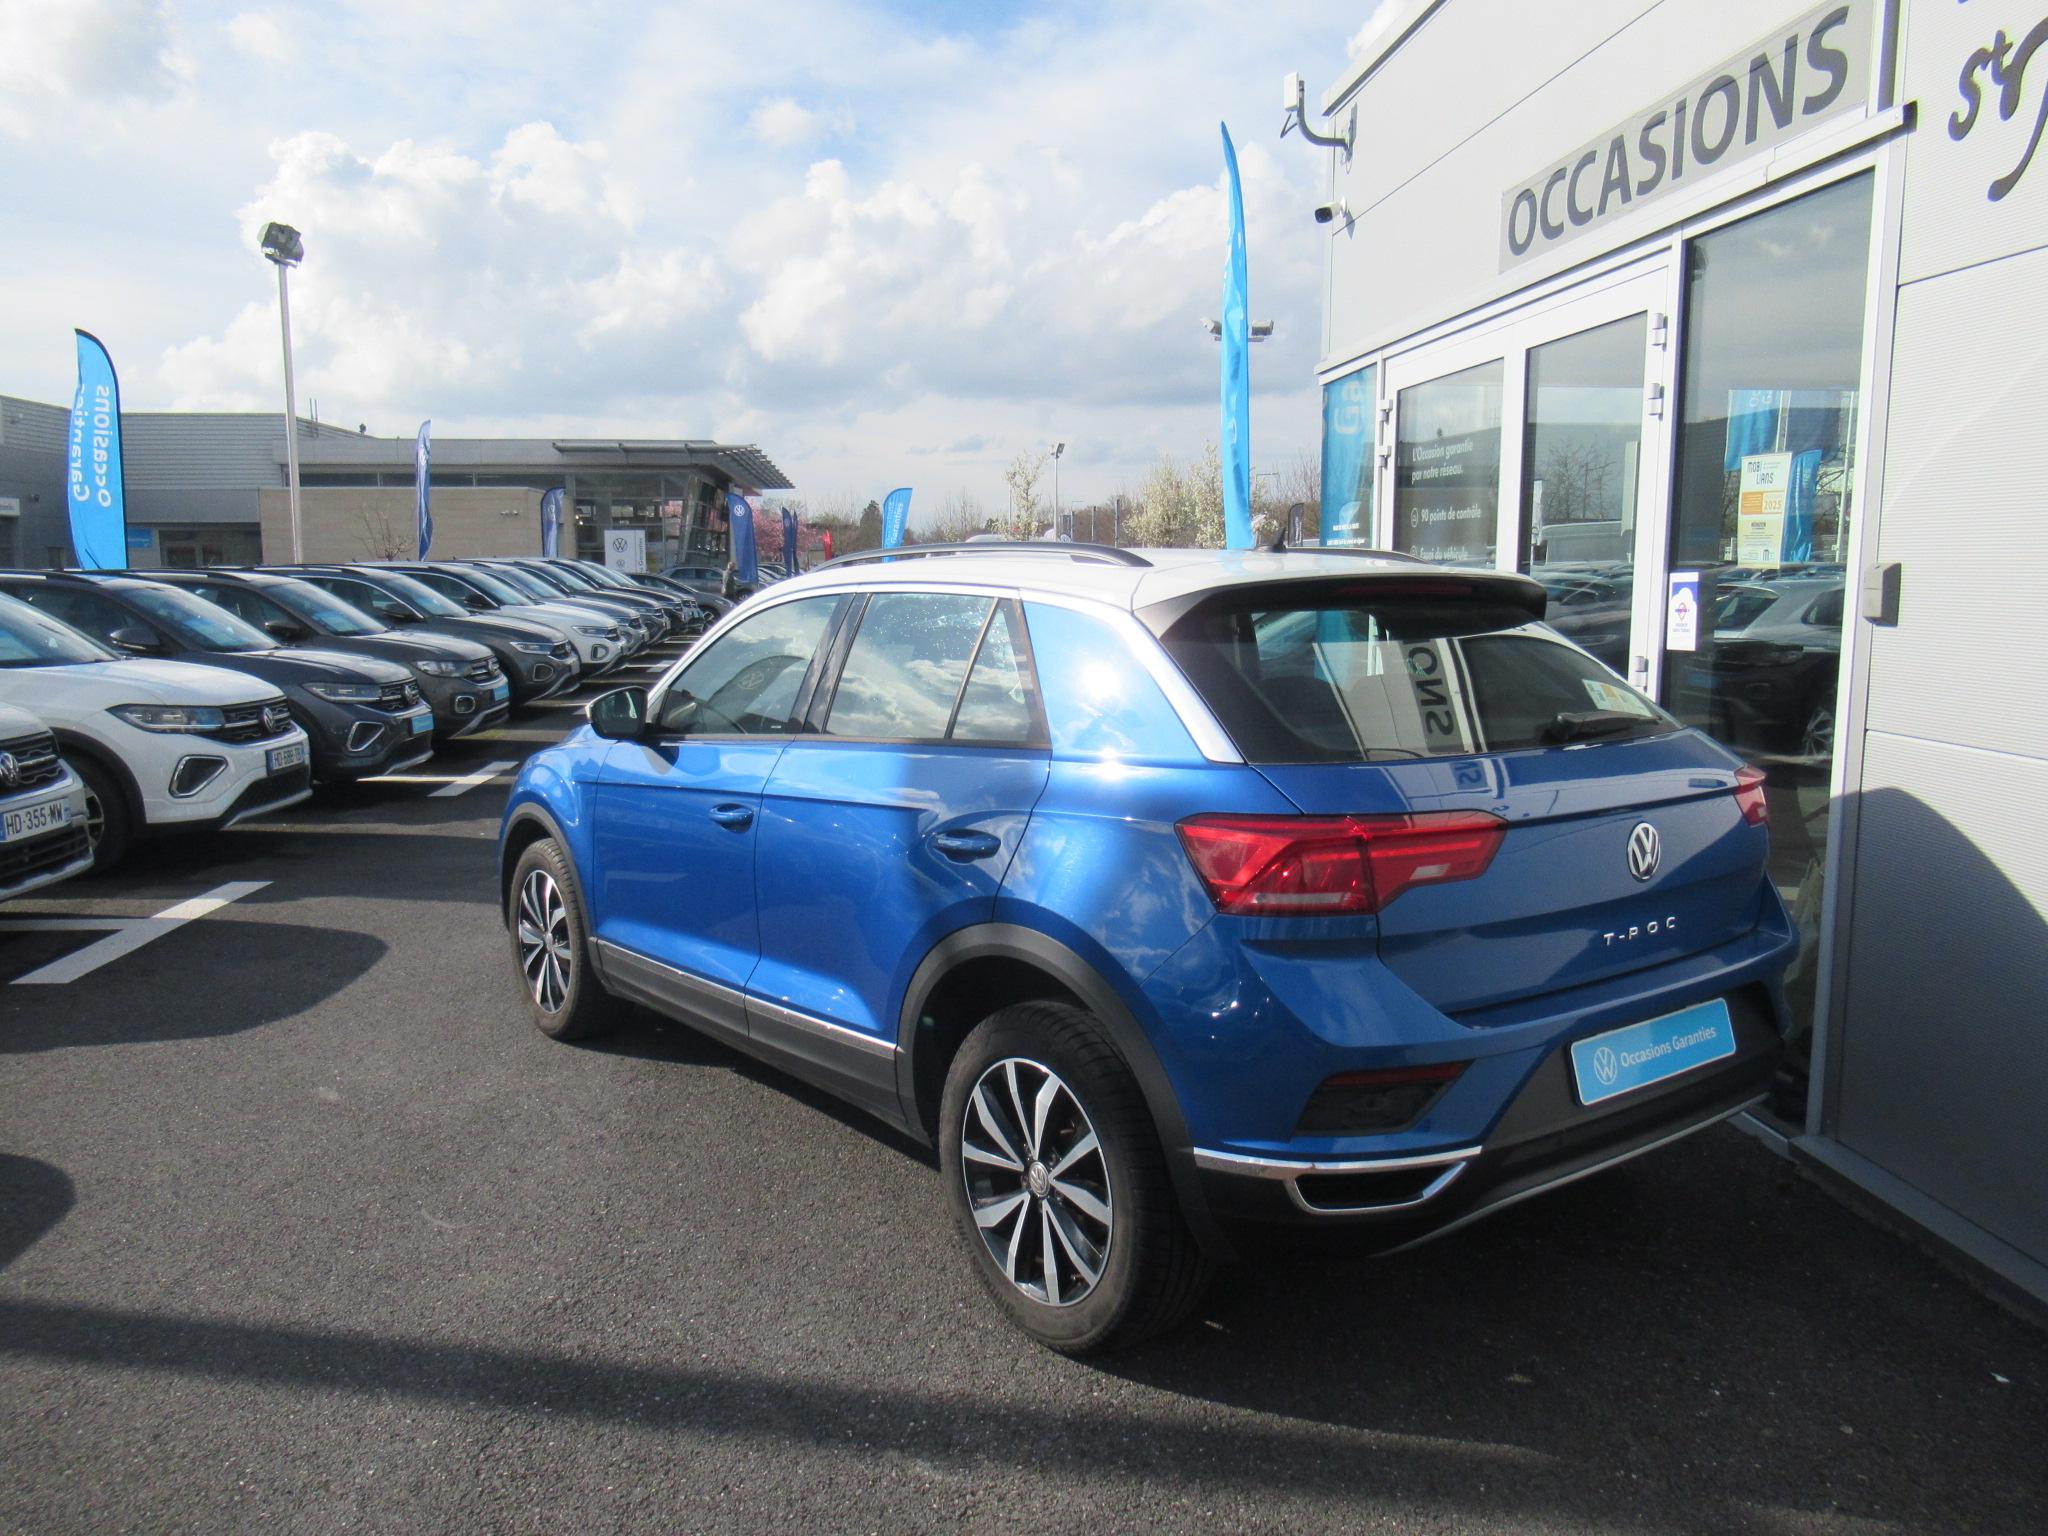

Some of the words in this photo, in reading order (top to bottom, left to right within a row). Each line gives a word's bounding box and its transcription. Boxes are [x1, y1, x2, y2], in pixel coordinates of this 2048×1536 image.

[1508, 5, 1850, 256] OCCASIONS
[1411, 471, 1422, 485] par
[1423, 466, 1438, 480] notre
[1421, 508, 1429, 522] 90
[1430, 508, 1447, 525] points
[1447, 506, 1456, 520] de
[5, 803, 63, 835] HD-355-MW
[1620, 1043, 1672, 1067] Occasions
[1672, 1026, 1717, 1050] Garanties
